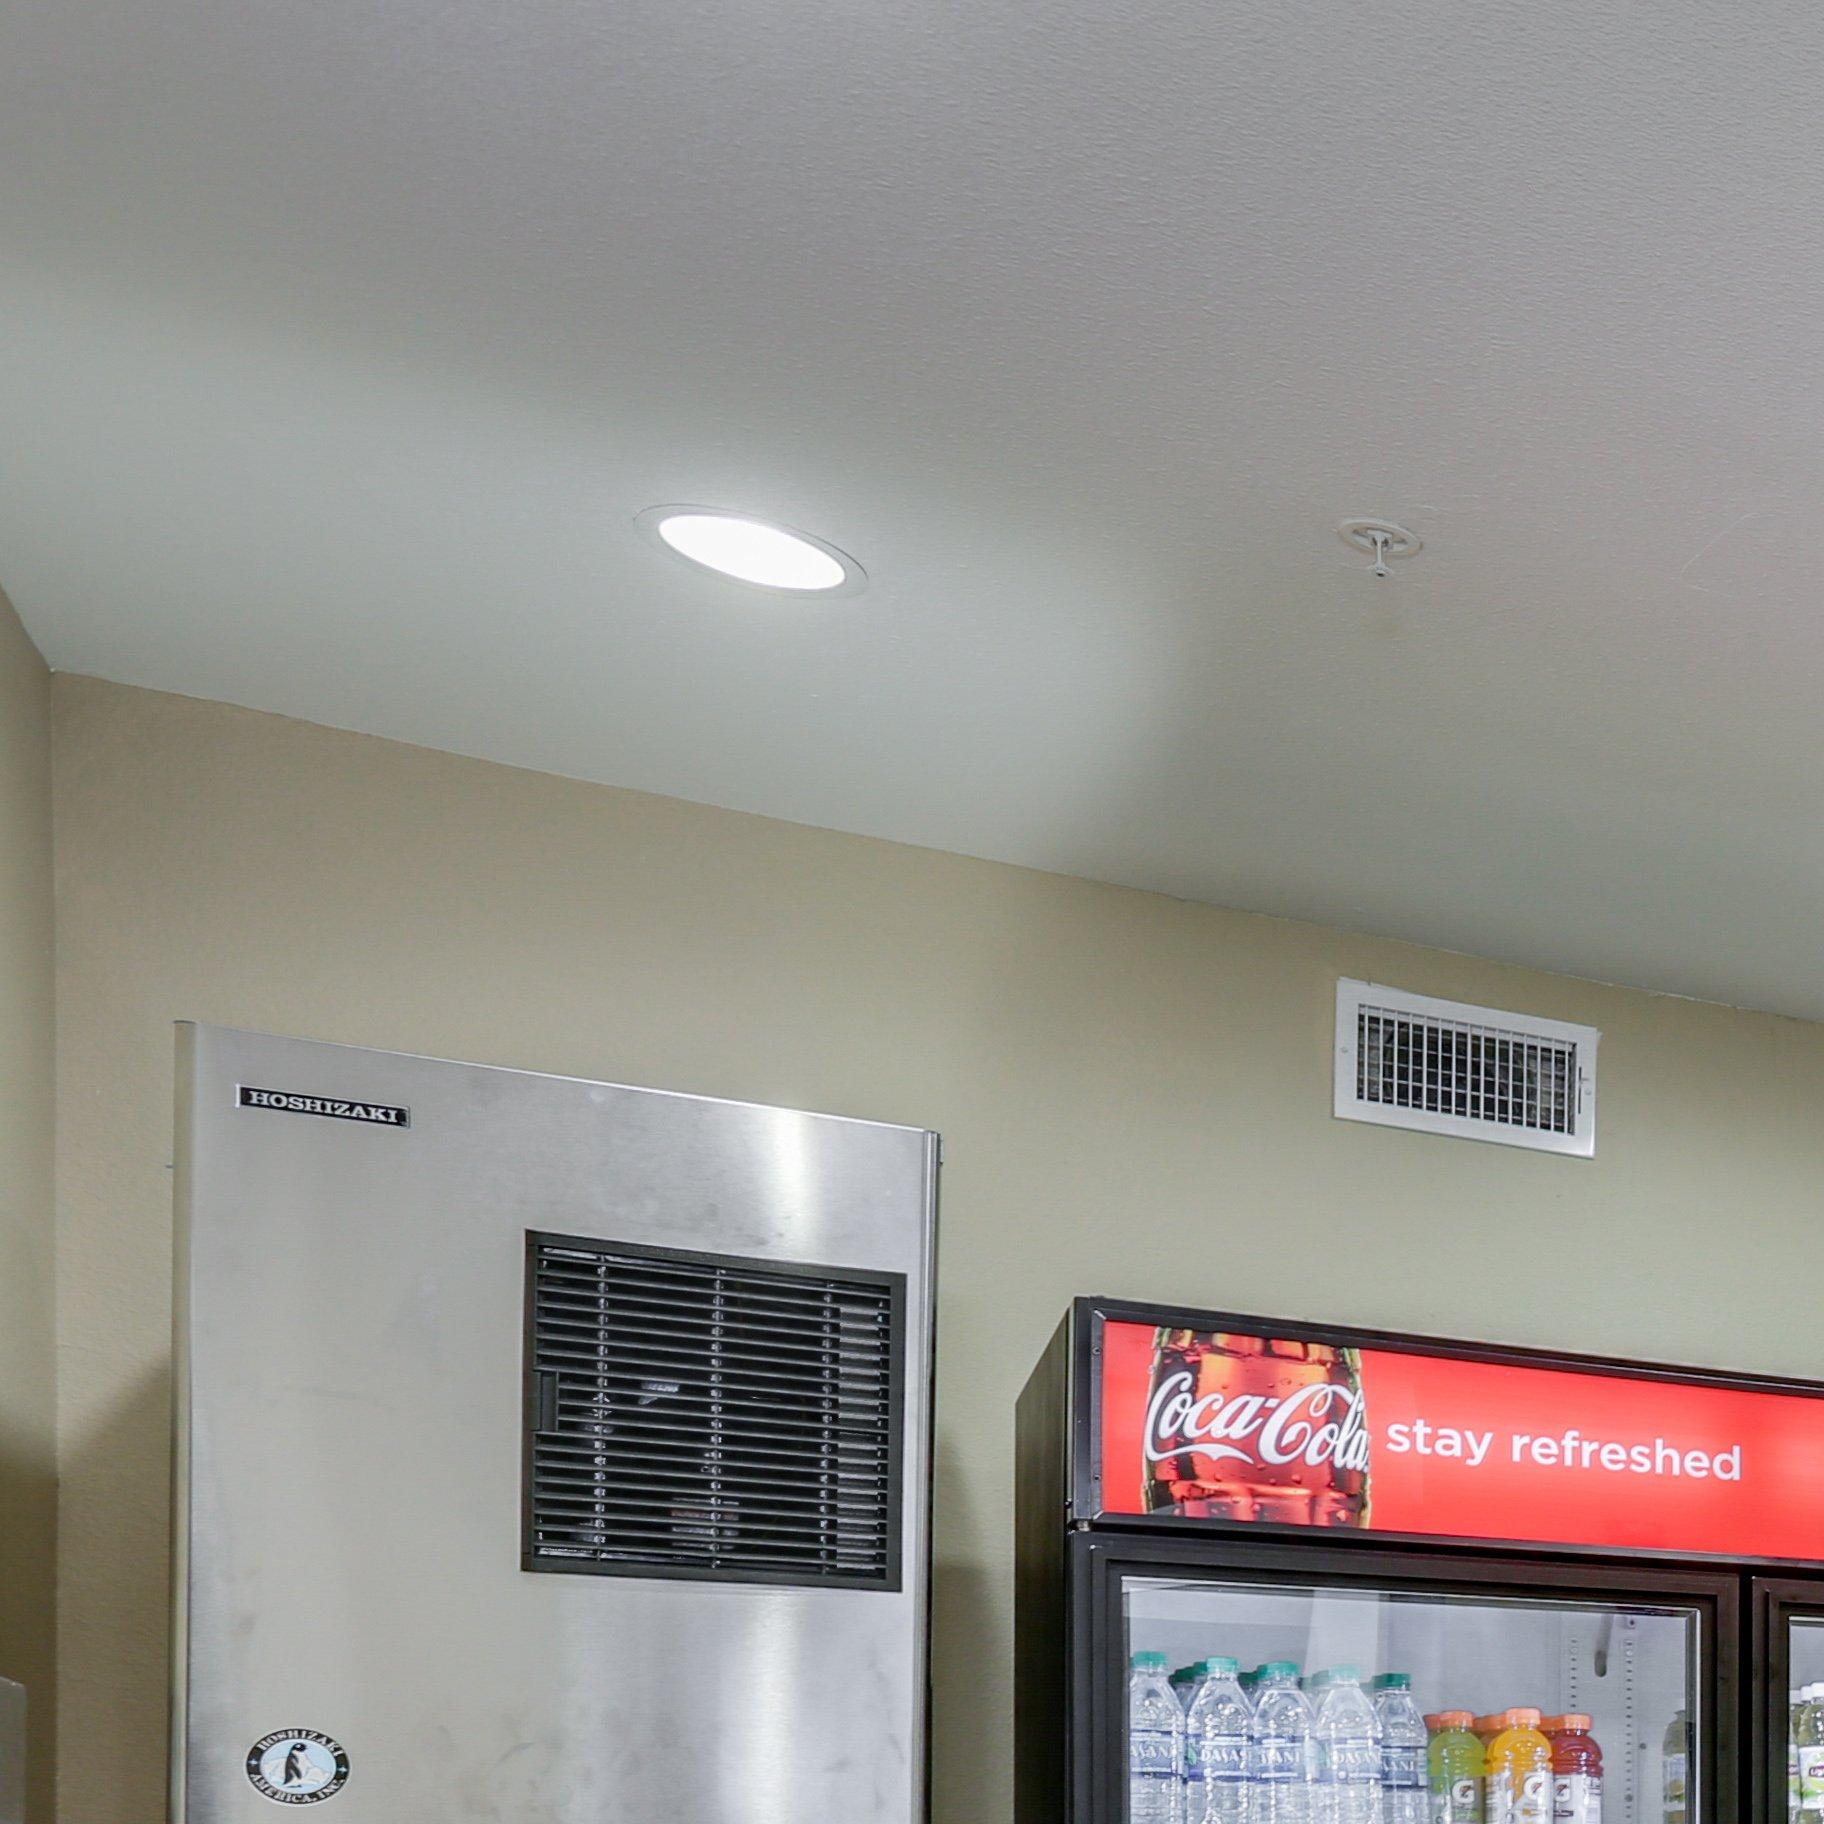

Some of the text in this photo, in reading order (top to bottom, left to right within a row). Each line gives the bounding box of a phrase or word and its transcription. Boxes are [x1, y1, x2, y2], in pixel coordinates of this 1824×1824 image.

[249, 1090, 398, 1123] HOSHIZAKI
[1145, 1370, 1370, 1468] Coca-Cola
[1386, 1417, 1742, 1483] stay refreshed
[257, 1730, 344, 1757] HOSHIZAKI
